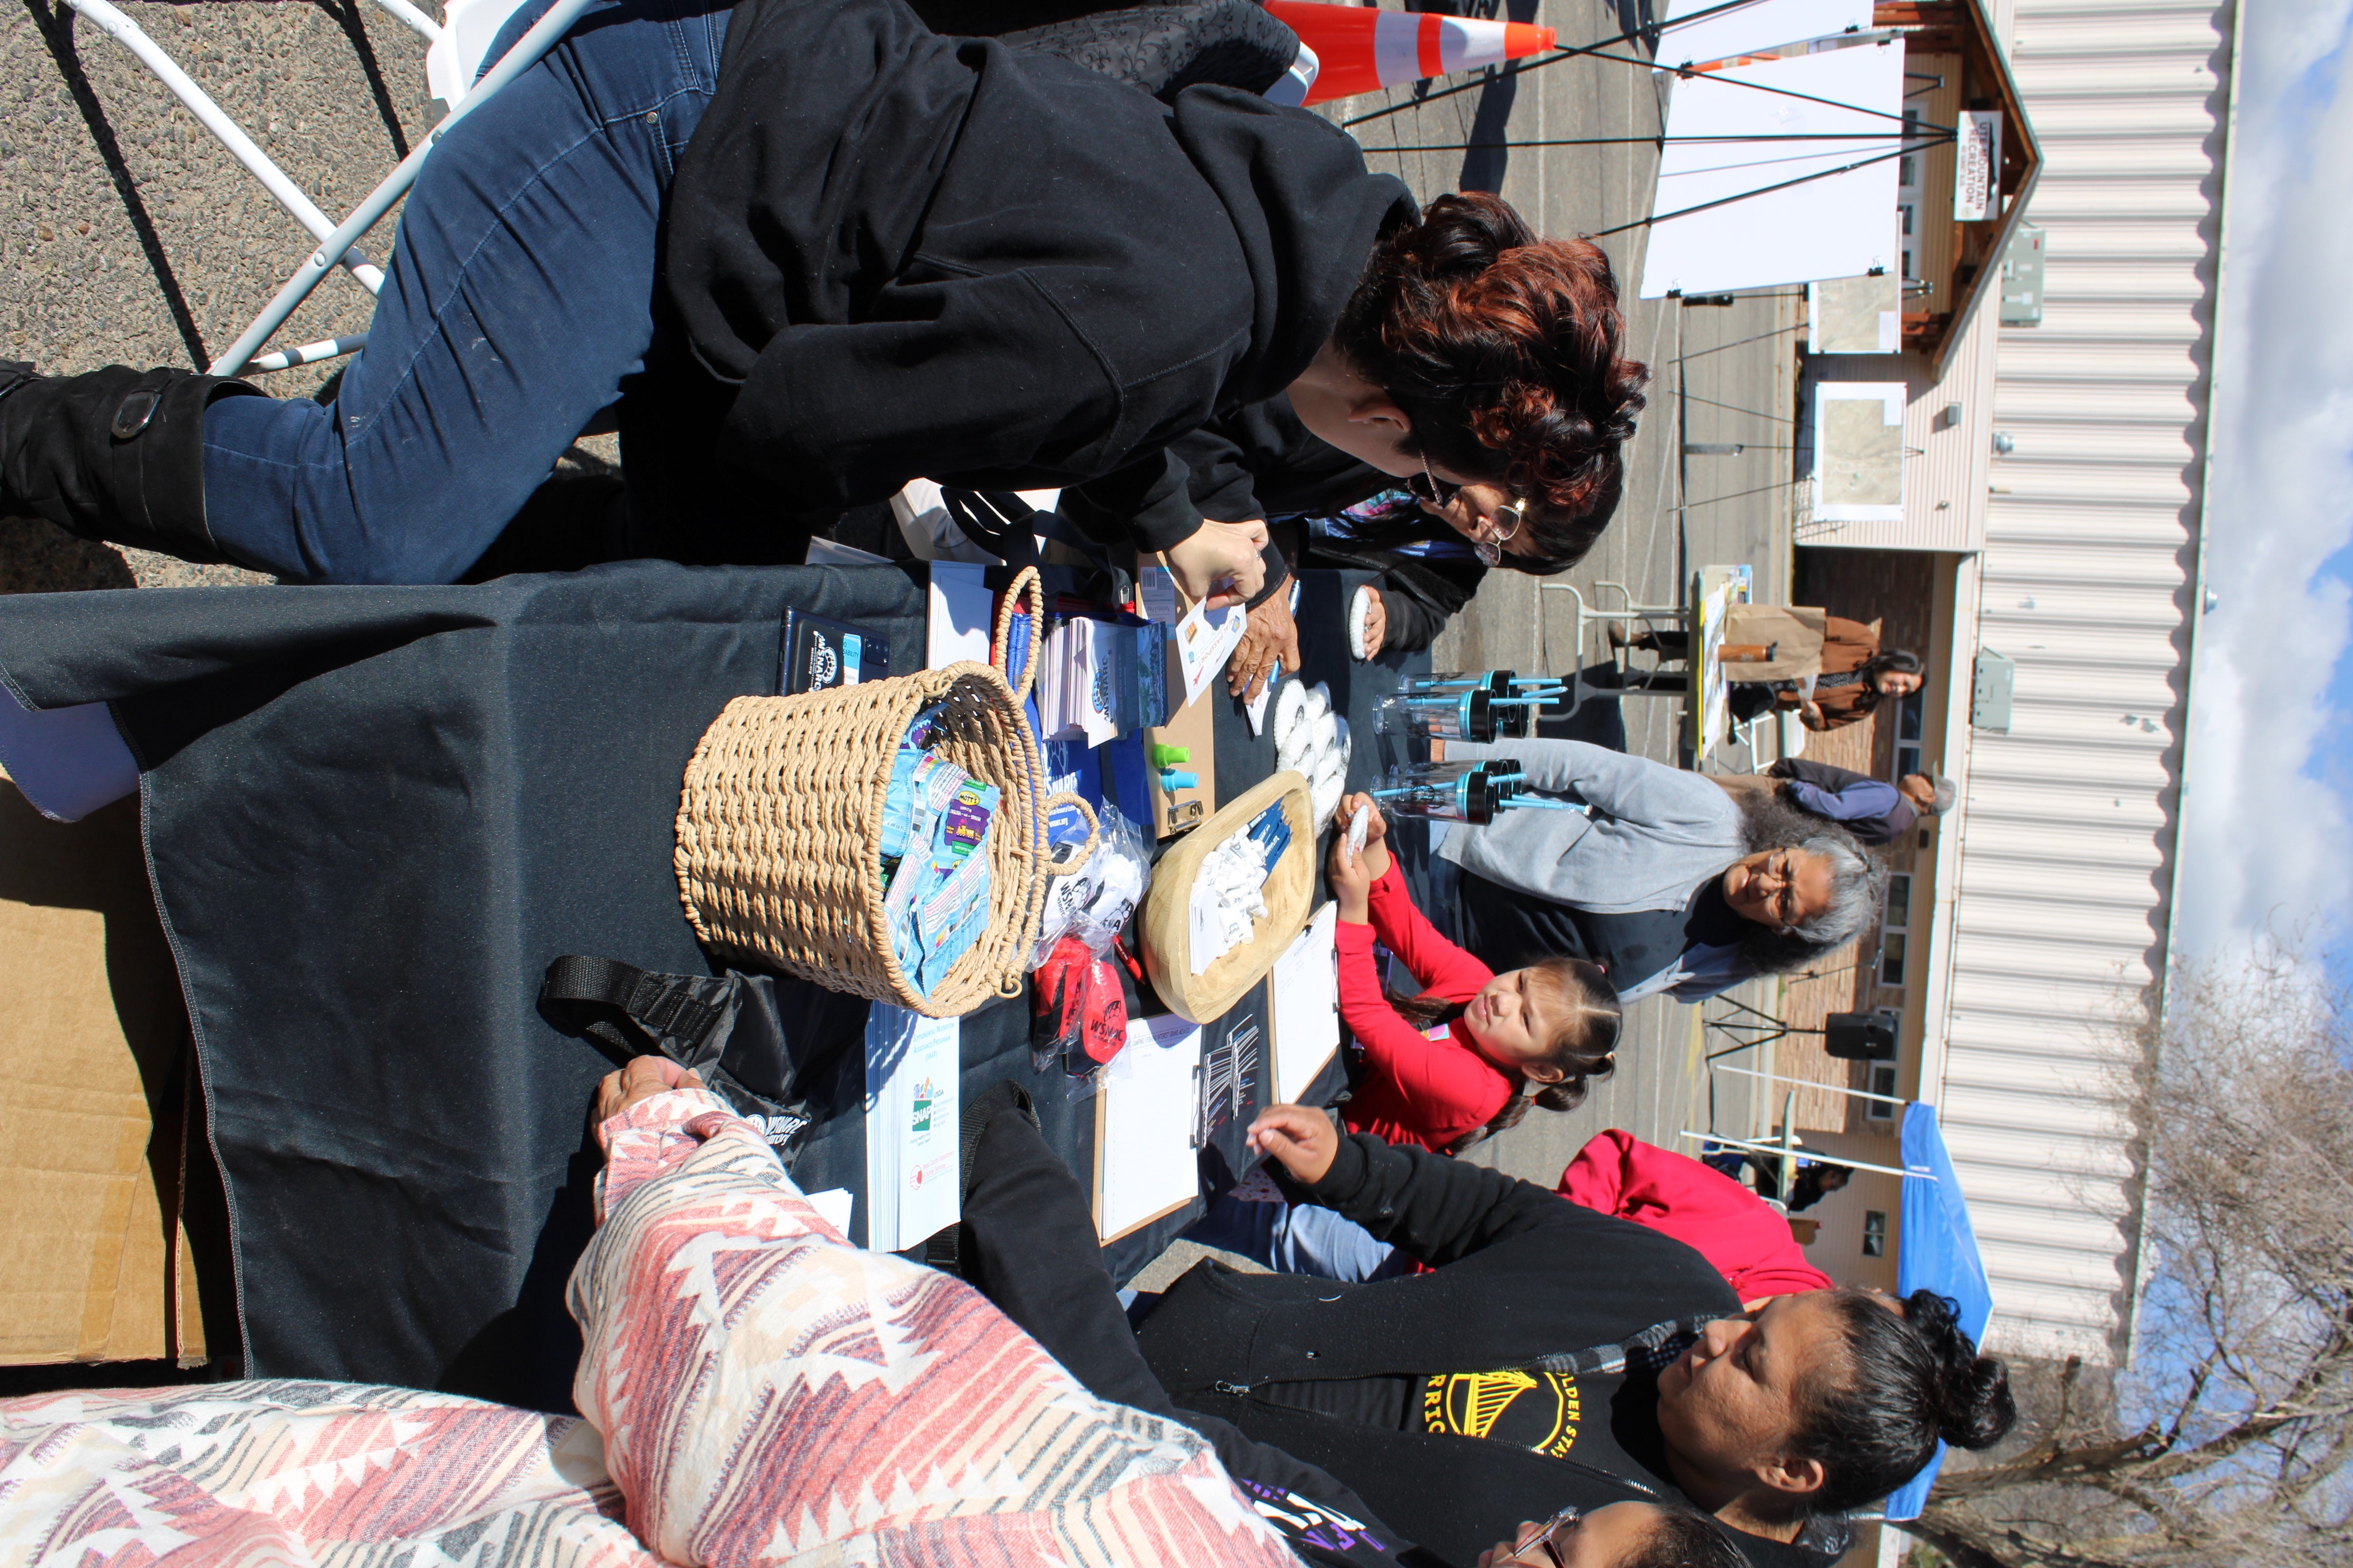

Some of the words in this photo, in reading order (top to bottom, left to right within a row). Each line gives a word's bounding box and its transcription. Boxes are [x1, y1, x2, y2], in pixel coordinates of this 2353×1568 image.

[1978, 122, 1988, 145] UTE
[1966, 128, 1978, 203] RECREATION
[1976, 148, 1988, 211] MOUNTAIN
[814, 637, 826, 689] WSNARC
[843, 649, 859, 658] SABILITY
[959, 794, 978, 804] MOTT'S
[1132, 1037, 1144, 1046] CAMPING
[1157, 1032, 1169, 1040] INTEREST
[1170, 1029, 1179, 1037] GRAND
[934, 1089, 944, 1098] USDA
[912, 1105, 932, 1126] SNAP
[1556, 1373, 1580, 1421] LDEN
